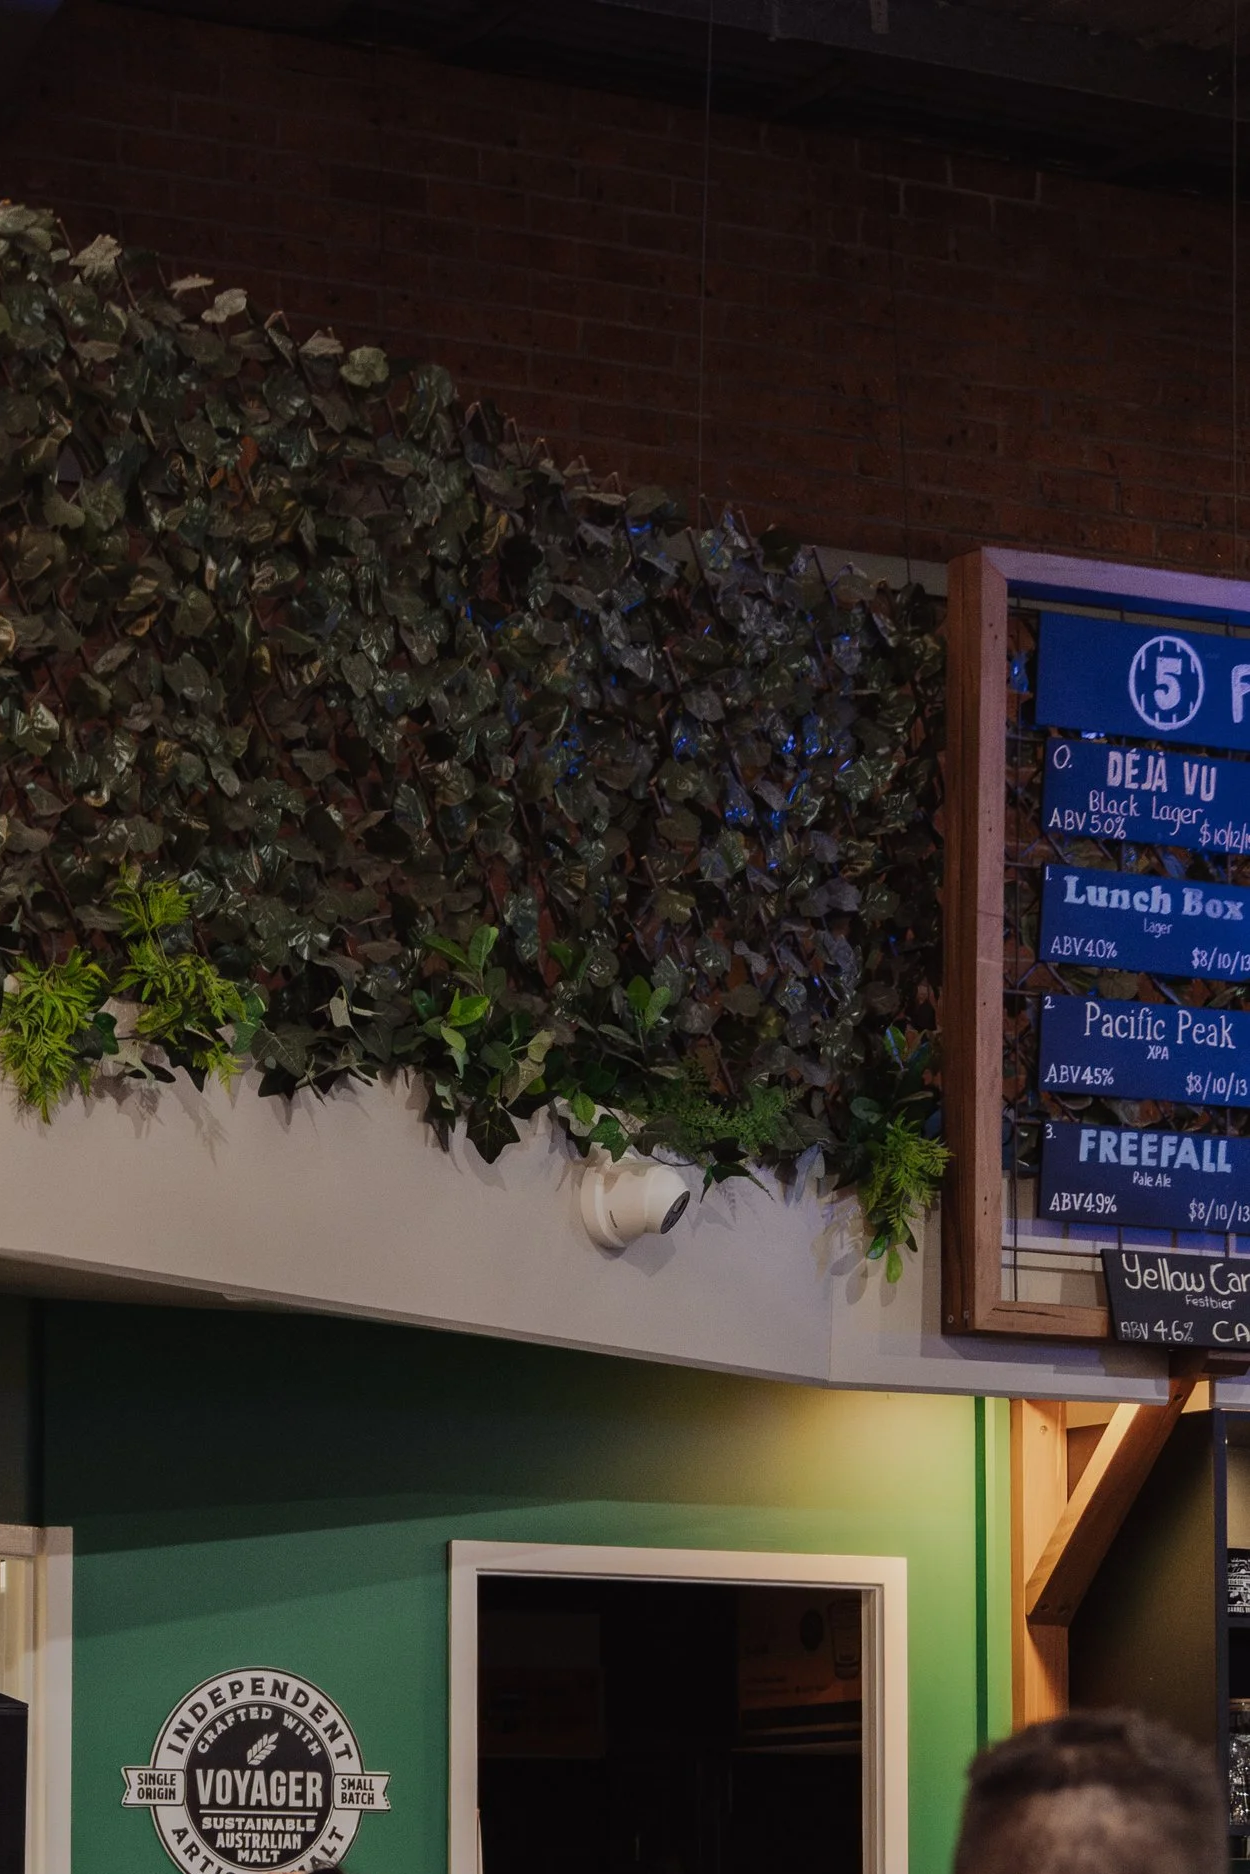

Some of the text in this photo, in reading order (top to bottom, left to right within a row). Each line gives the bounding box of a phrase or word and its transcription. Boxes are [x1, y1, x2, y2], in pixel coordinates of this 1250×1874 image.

[1153, 656, 1250, 724] 5 F
[1106, 748, 1218, 802] DÉJÀ VU
[1048, 807, 1087, 831] ABV
[1088, 789, 1204, 836] Black Lager
[1063, 874, 1244, 921] Lunch Box
[1143, 917, 1174, 939] Lager
[1050, 935, 1085, 957] ABV
[1191, 947, 1250, 975] $8/10/13
[1083, 1001, 1237, 1050] Pacific Peak
[1146, 1045, 1170, 1061] XPA
[1044, 1062, 1081, 1083] ABV
[1185, 1071, 1248, 1102] $8/10/13
[1045, 1123, 1057, 1139] 3.
[1078, 1128, 1232, 1174] FREEFALL
[1132, 1171, 1172, 1188] Pale Ale
[1049, 1192, 1118, 1214] ABV 4.9%
[1188, 1198, 1250, 1230] $8/10/13
[1121, 1252, 1206, 1293] Yellow
[1184, 1293, 1237, 1311] Festbier
[1120, 1320, 1149, 1340] ABV
[1152, 1319, 1195, 1343] 4.6%
[166, 1676, 353, 1761] INDEPENDENT
[196, 1706, 323, 1757] CRAFTED WITH
[137, 1772, 177, 1787] SINGLE
[195, 1768, 324, 1809] VOYAGER
[340, 1777, 375, 1792] SMALL
[137, 1787, 177, 1801] ORIGIN
[340, 1791, 376, 1805] BATCH
[201, 1816, 317, 1833] SUSTAINABLE
[215, 1833, 302, 1850] AUSTRALIAN
[236, 1850, 281, 1863] MALT
